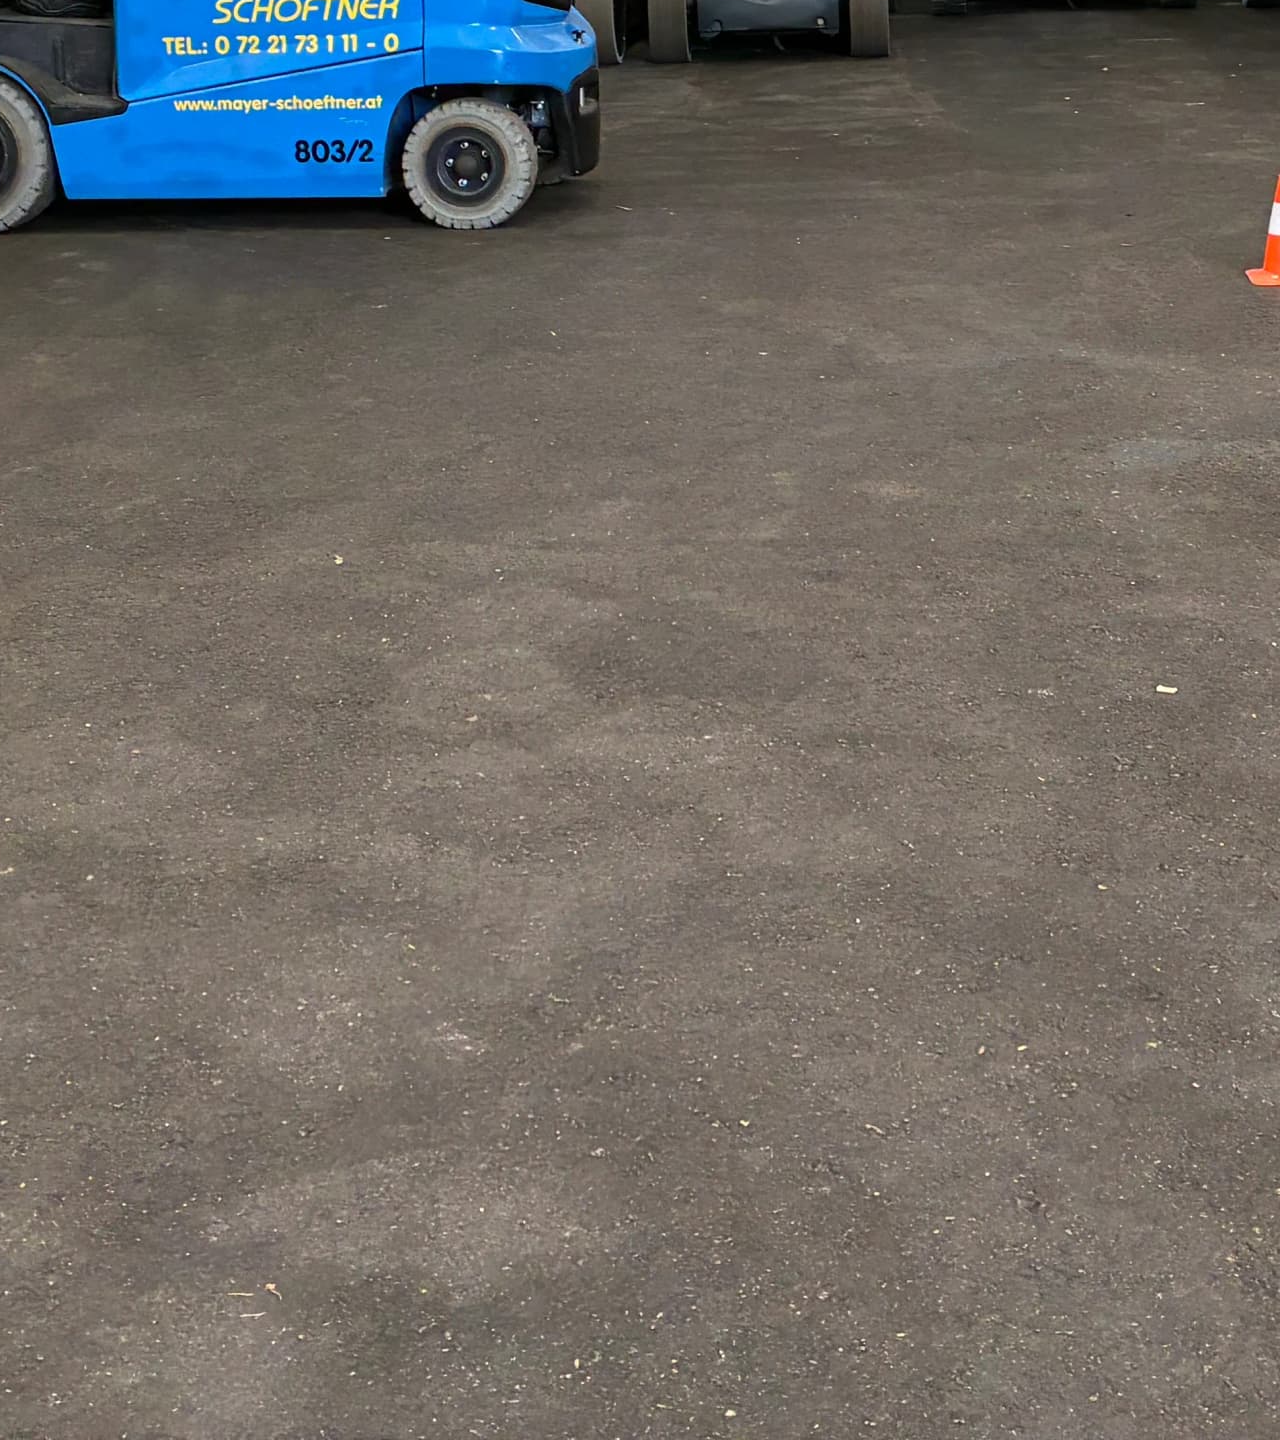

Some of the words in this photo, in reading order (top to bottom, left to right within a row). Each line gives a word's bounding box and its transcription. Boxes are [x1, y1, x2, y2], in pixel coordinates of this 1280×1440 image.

[162, 36, 209, 56] TEL.:
[214, 35, 231, 55] 0
[236, 35, 261, 55] 72
[267, 34, 288, 54] 21
[295, 34, 319, 54] 73
[326, 33, 334, 53] 1
[341, 33, 358, 53] 11
[383, 32, 400, 52] 0
[173, 94, 383, 115] www.mayer-schoeftner.at
[294, 139, 375, 164] 803/2
